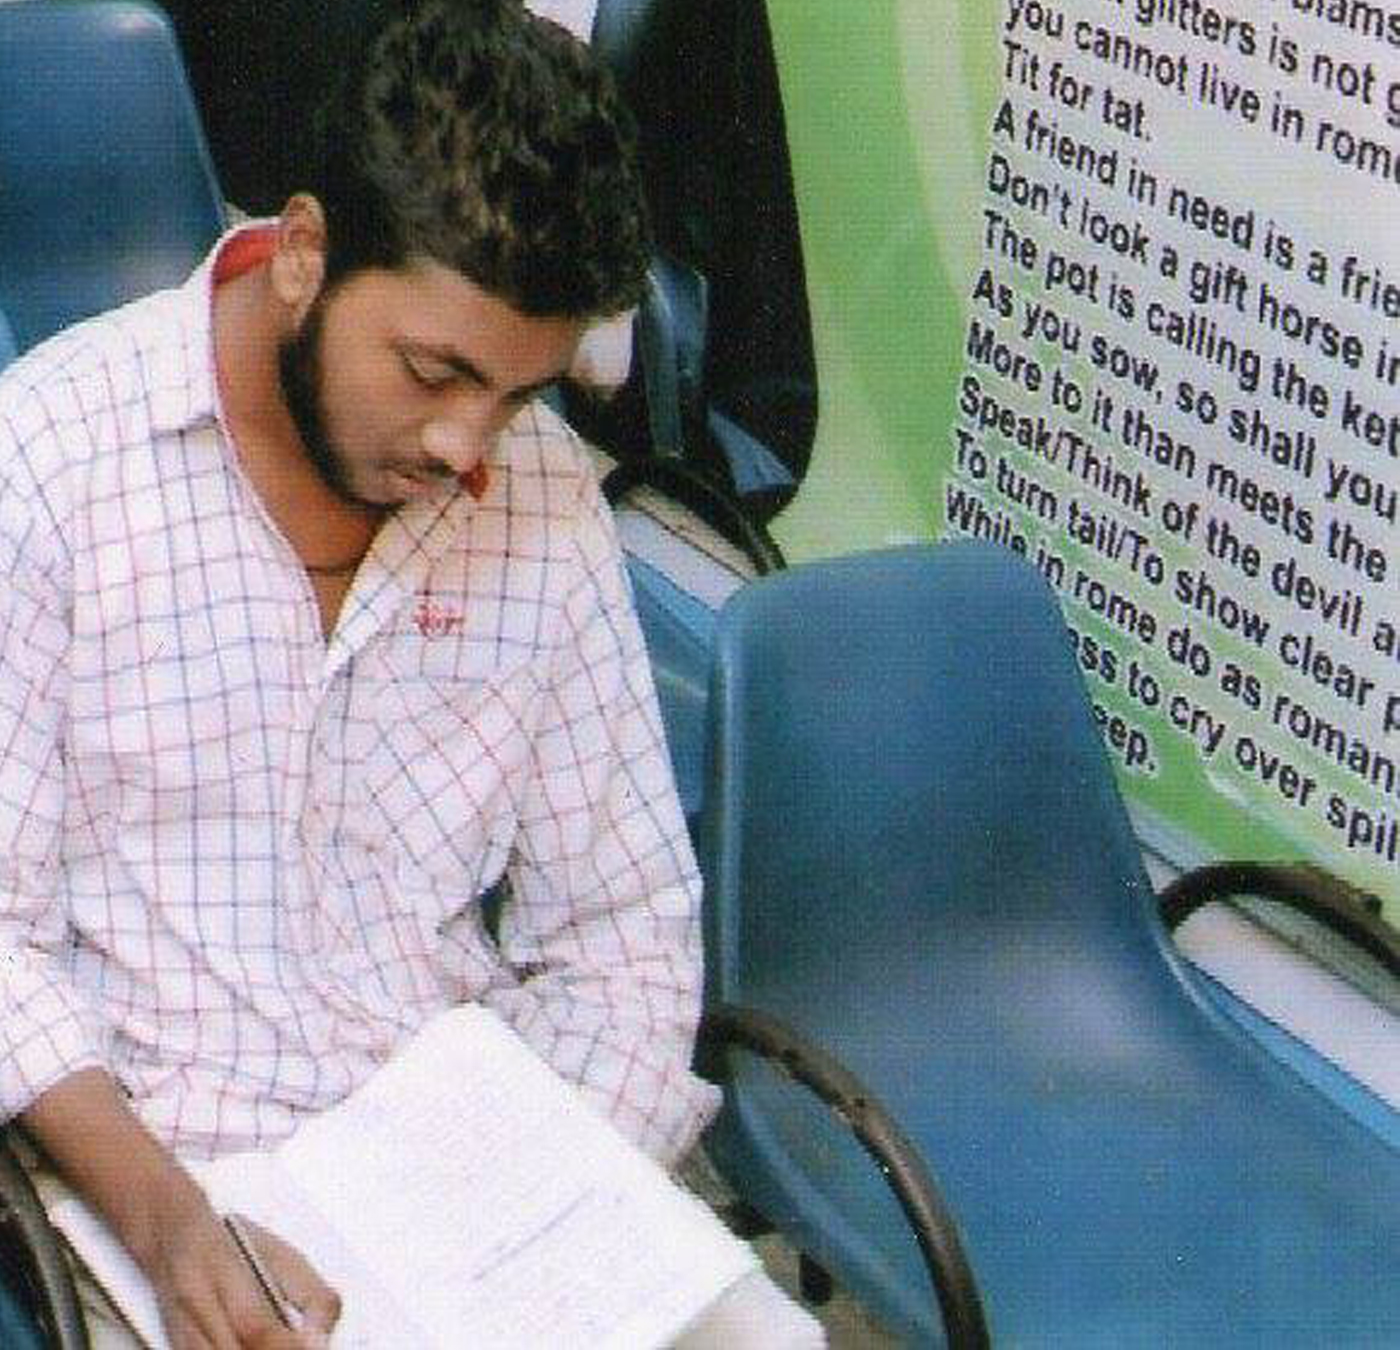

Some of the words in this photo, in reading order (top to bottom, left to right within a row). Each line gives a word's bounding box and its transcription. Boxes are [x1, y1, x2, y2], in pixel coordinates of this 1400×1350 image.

[1001, 38, 1041, 91] Tit
[1048, 60, 1094, 112] for
[1103, 88, 1151, 143] tat.
[1074, 19, 1188, 93] cannot
[1200, 61, 1261, 124] live
[1271, 91, 1305, 144] in
[1269, 23, 1299, 75] is
[1312, 52, 1378, 105] not
[988, 154, 1073, 230] Don't
[1080, 197, 1150, 266] look
[1159, 245, 1179, 279] a
[1190, 260, 1249, 312] gift
[1259, 283, 1364, 369] horse
[993, 98, 1016, 144] A
[1025, 108, 1118, 188] friend
[1128, 158, 1158, 206] in
[1169, 186, 1255, 251] need
[1264, 220, 1295, 271] is
[1308, 251, 1328, 286] a
[973, 269, 1014, 319] As
[1021, 301, 1081, 356] you
[1091, 334, 1164, 406] sow,
[1175, 381, 1219, 426] so
[1228, 405, 1317, 479] shall
[1323, 458, 1398, 525] you
[984, 209, 1038, 271] The
[1045, 254, 1101, 305] pot
[1108, 275, 1136, 321] is
[1147, 300, 1262, 395] calling
[1272, 357, 1330, 420] the
[960, 376, 1152, 518] Speak/Think
[1161, 501, 1200, 540] of
[1206, 517, 1261, 578] the
[1271, 557, 1364, 637] devil
[966, 322, 1043, 392] More
[1050, 370, 1082, 414] to
[1091, 390, 1114, 433] it
[1123, 409, 1196, 479] than
[1206, 461, 1314, 545] meets
[1327, 520, 1387, 583] the
[947, 484, 1028, 558] While
[1036, 538, 1065, 587] in
[1073, 570, 1157, 644] rome
[1167, 626, 1211, 677] do
[1220, 662, 1261, 710] as
[955, 428, 987, 479] To
[997, 458, 1058, 521] turn
[1068, 501, 1165, 586] tail/To
[1174, 569, 1270, 649] show
[1279, 631, 1376, 707] clear
[1129, 661, 1160, 706] to
[1170, 695, 1225, 755] cry
[1235, 736, 1316, 808] over
